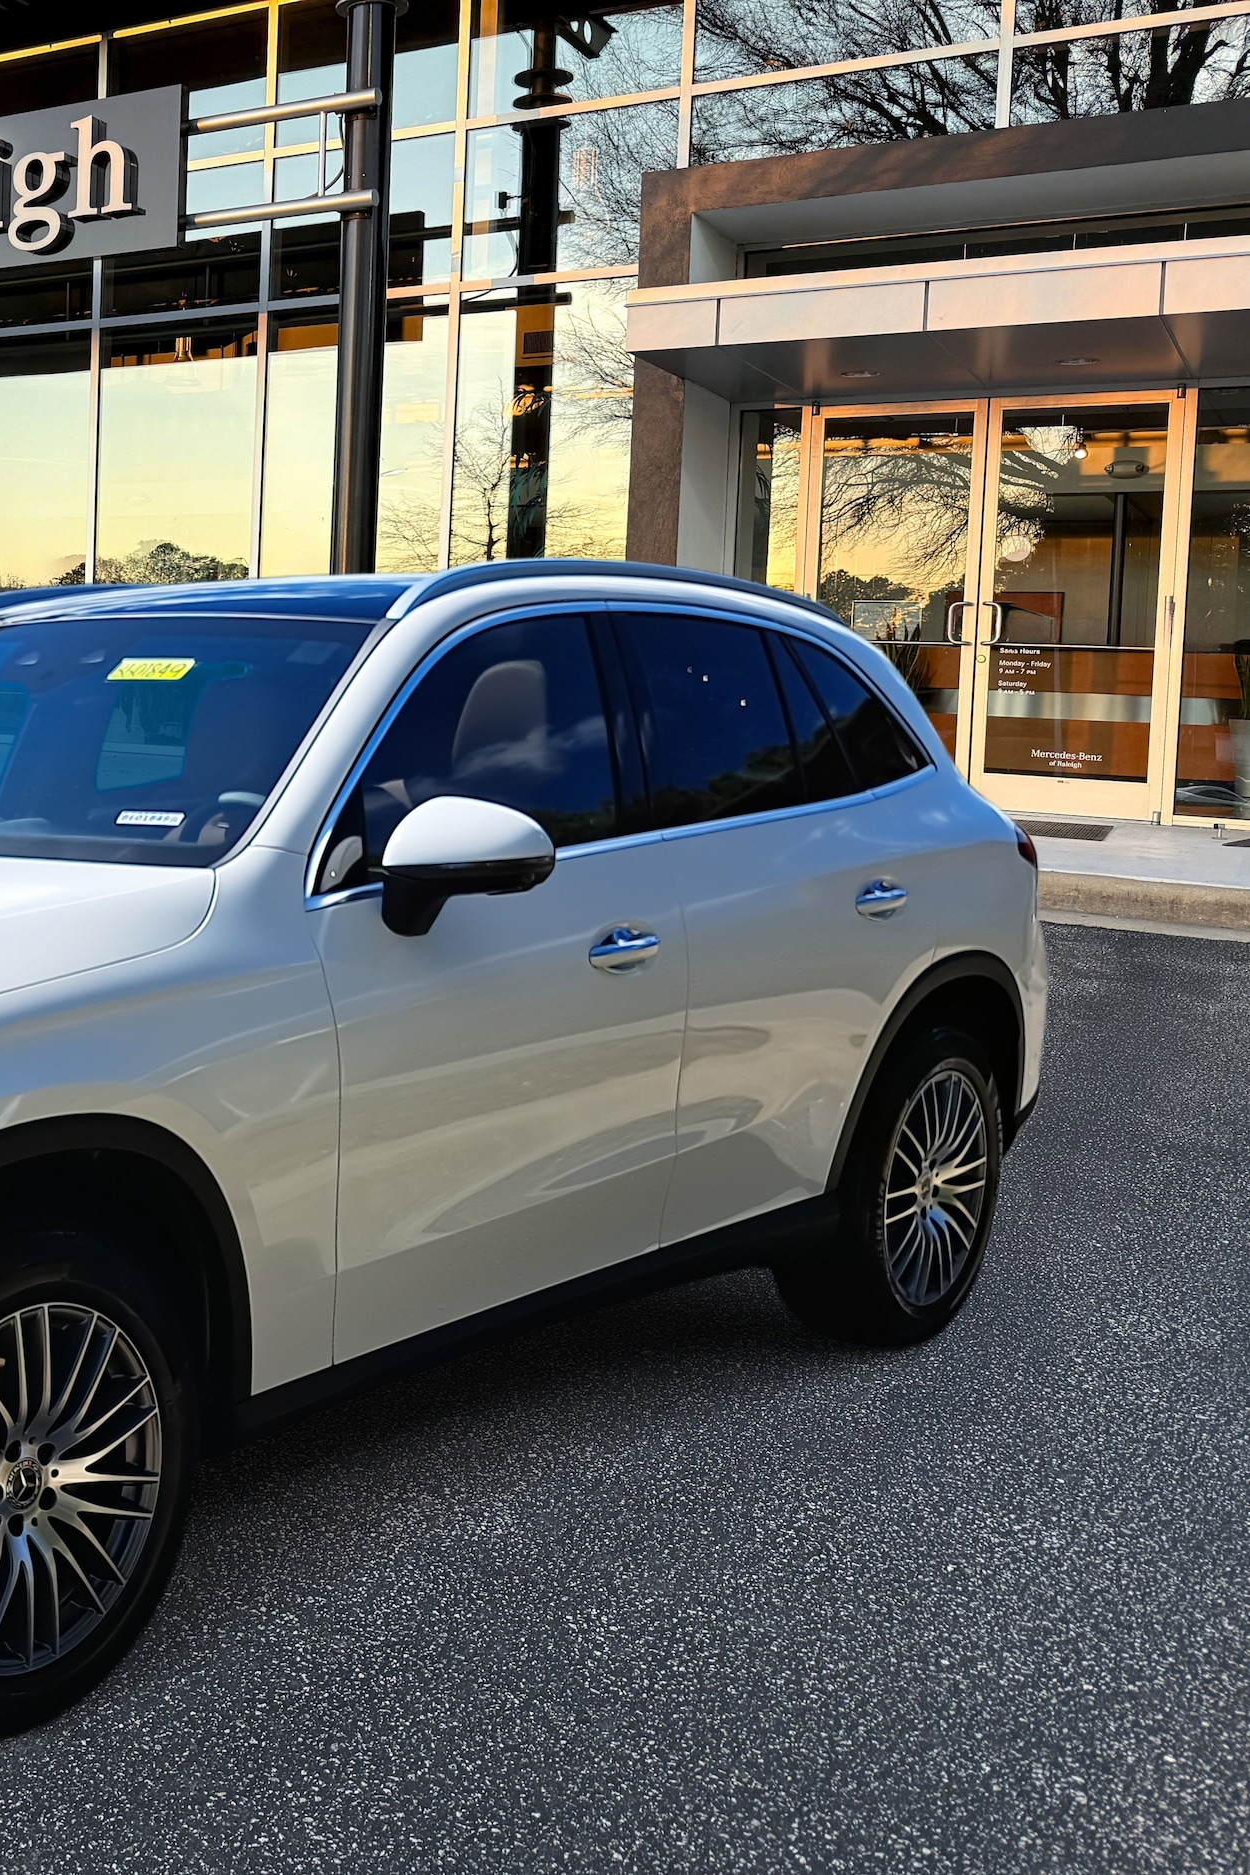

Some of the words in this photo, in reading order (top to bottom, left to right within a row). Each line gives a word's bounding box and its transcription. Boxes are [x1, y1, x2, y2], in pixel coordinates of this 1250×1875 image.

[998, 659, 1026, 668] Monday
[1030, 660, 1052, 669] Friday
[997, 680, 1028, 689] Saturday
[1030, 748, 1103, 762] Mercedes-Benz
[1057, 761, 1082, 769] Raleigh
